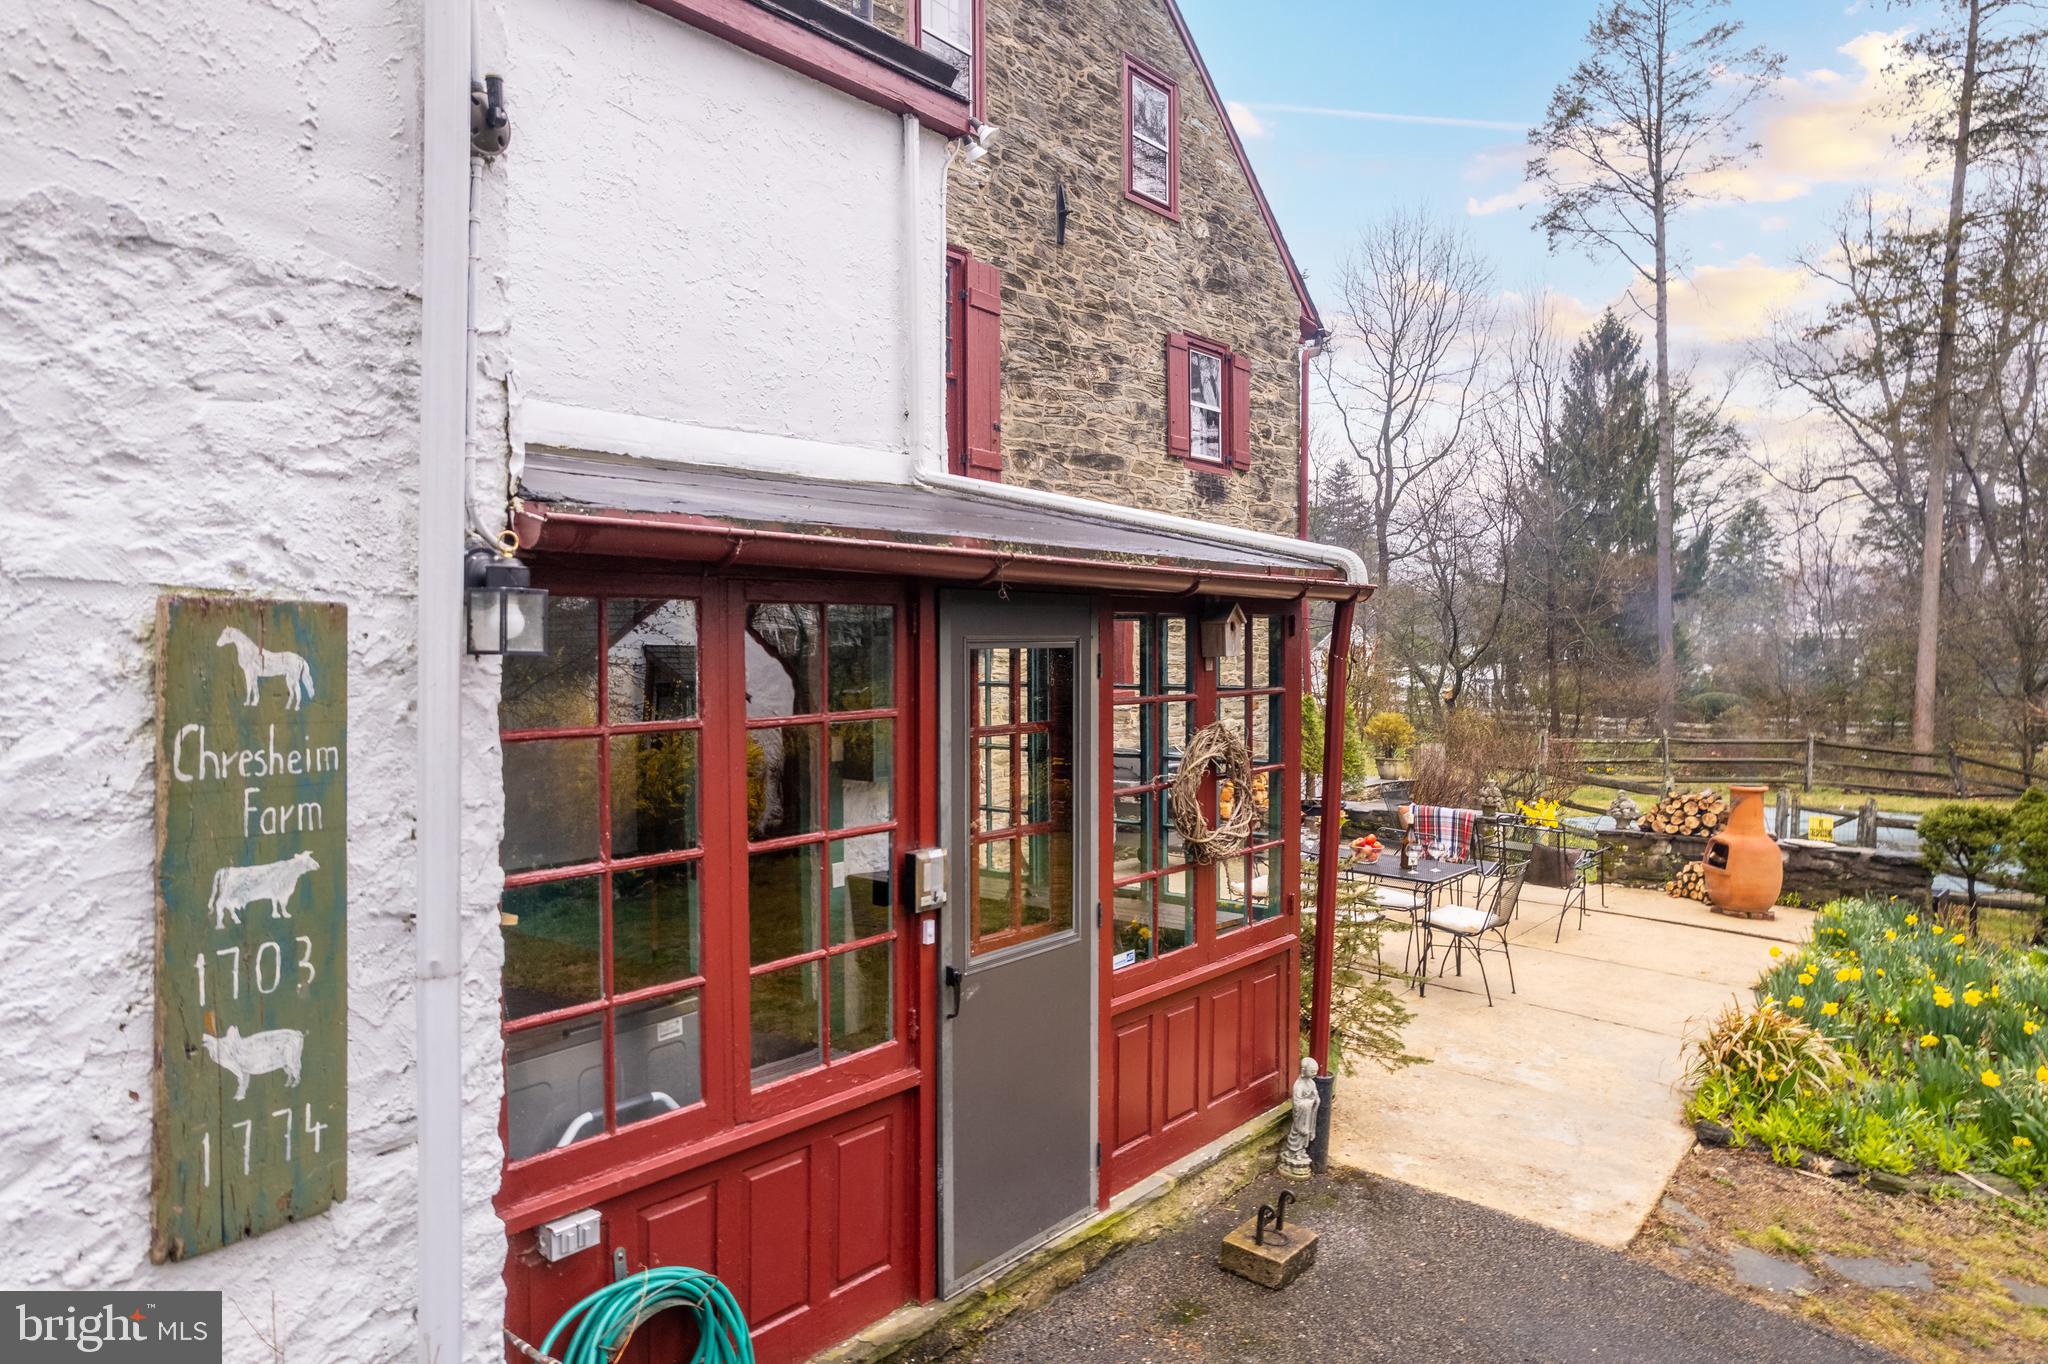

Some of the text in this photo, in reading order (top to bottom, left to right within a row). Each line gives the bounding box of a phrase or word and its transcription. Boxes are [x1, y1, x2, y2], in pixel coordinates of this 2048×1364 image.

[173, 723, 339, 782] Chresheim
[243, 787, 323, 838] Farm
[194, 935, 316, 1007] 1703
[202, 1103, 328, 1187] 1774
